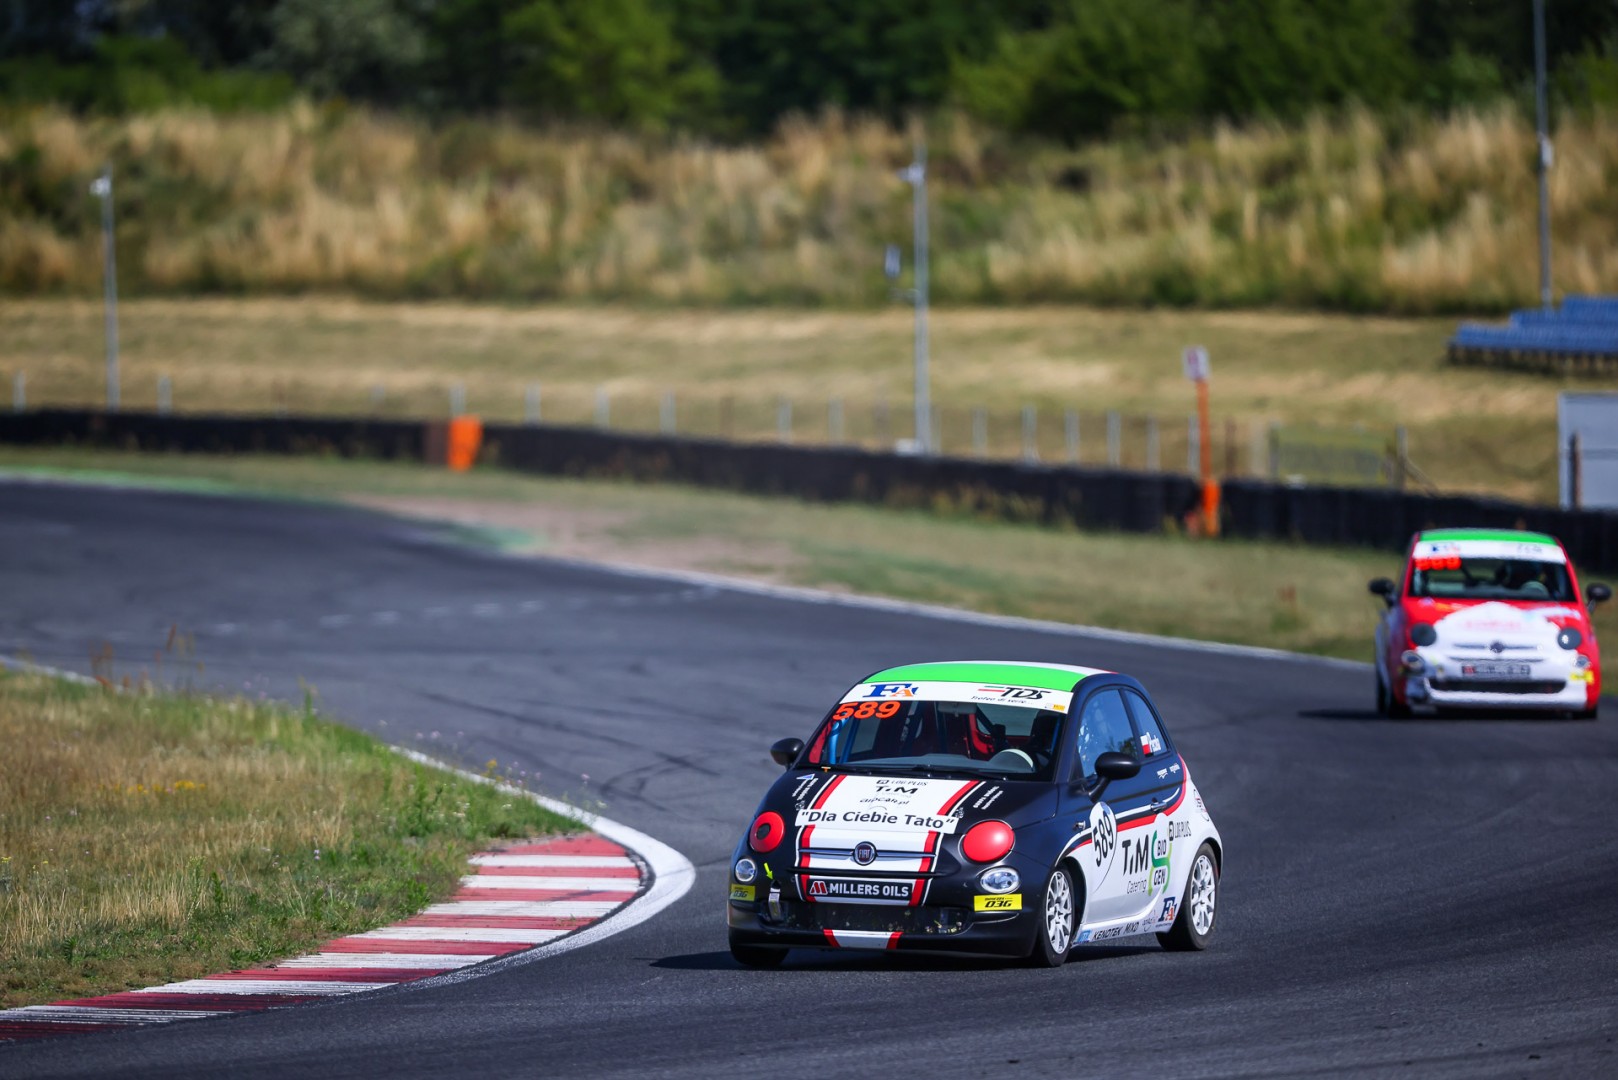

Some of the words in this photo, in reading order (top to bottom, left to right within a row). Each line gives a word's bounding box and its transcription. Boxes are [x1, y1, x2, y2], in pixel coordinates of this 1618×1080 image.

[1000, 686, 1052, 700] TDS
[832, 700, 900, 720] 589
[843, 811, 898, 824] Ciebie
[1092, 811, 1114, 867] 589
[858, 849, 871, 859] FIAT
[1157, 839, 1167, 856] BIO
[1153, 869, 1166, 886] GEN
[829, 882, 880, 895] MILLERS
[882, 885, 909, 897] OILS
[1126, 879, 1147, 895] Catering
